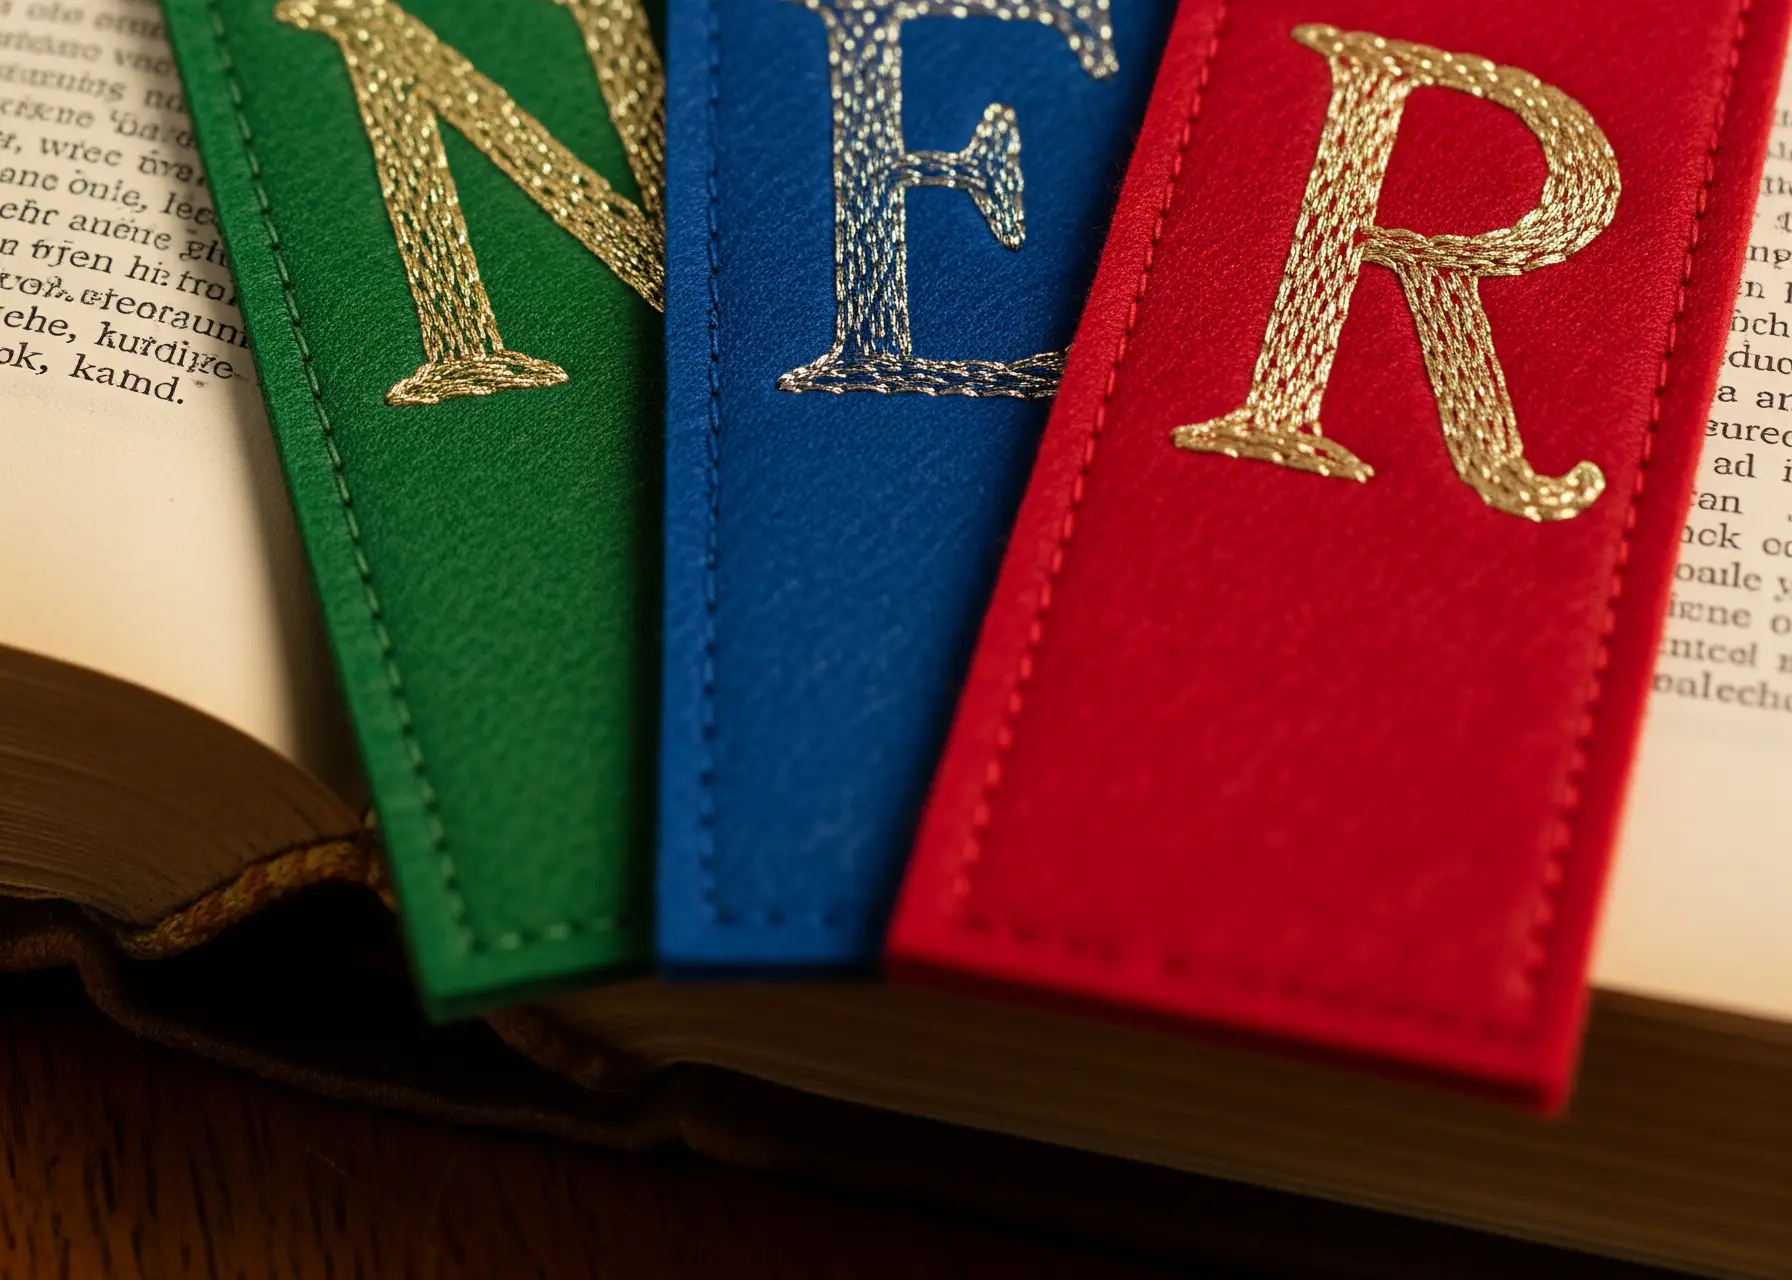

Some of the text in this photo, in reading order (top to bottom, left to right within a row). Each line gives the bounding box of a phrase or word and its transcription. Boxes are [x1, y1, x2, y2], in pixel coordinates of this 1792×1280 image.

[1171, 23, 1622, 523] R
[69, 352, 184, 405] kamd.
[1713, 453, 1757, 479] ad
